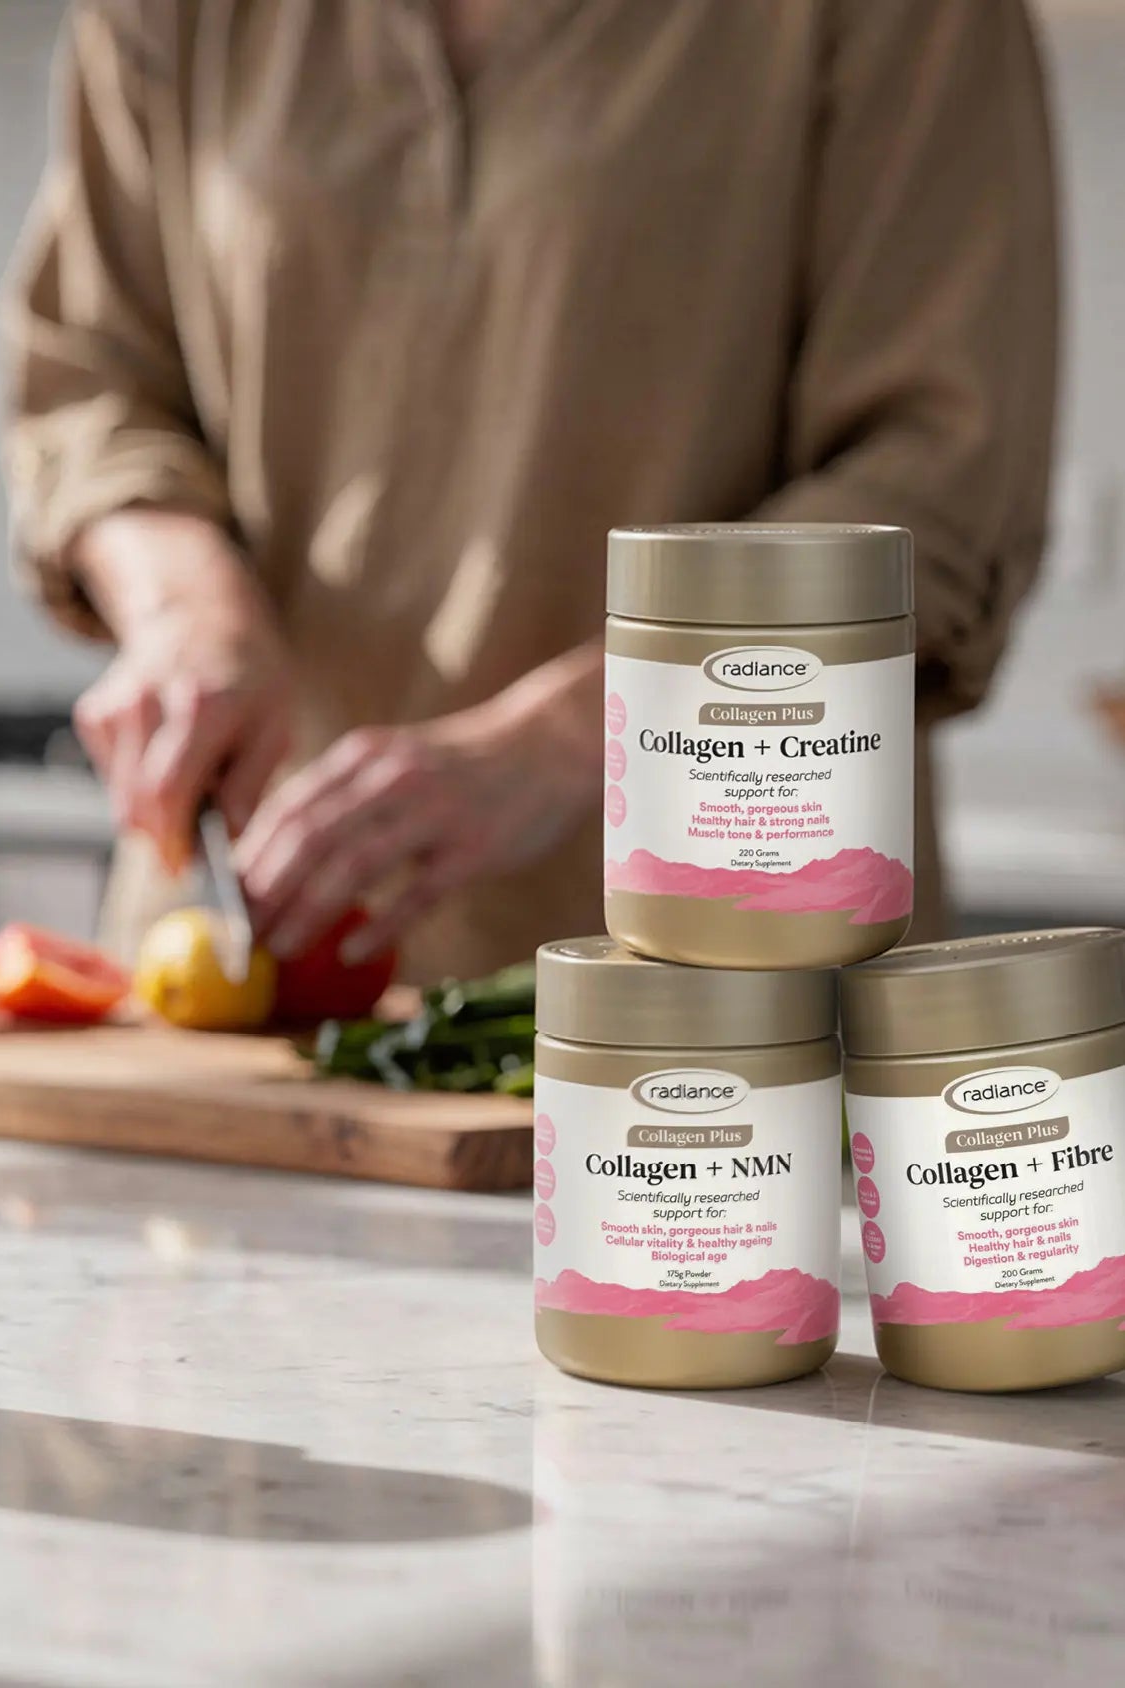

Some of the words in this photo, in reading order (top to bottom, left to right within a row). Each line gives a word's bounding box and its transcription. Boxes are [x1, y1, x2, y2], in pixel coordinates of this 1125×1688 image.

[710, 707, 776, 724] Collagen
[782, 707, 813, 720] Plus
[639, 728, 744, 763] Collagen
[755, 740, 770, 755] +
[780, 730, 881, 758] Creatine
[689, 769, 763, 785] Scientifically
[766, 769, 831, 782] researched
[725, 786, 774, 800] support
[778, 786, 798, 797] for:
[700, 802, 744, 814] Smooth,
[747, 803, 798, 815] gorgeous
[801, 802, 822, 812] skin
[692, 815, 732, 827] Healthy
[735, 815, 756, 826] hair
[759, 816, 766, 826] &
[769, 816, 804, 828] strong
[807, 815, 830, 824] nails
[688, 827, 725, 838] Muscle
[728, 830, 752, 839] tone
[755, 829, 763, 839] &
[766, 828, 834, 841] performance
[739, 849, 754, 857] 220
[756, 849, 779, 857] Grams
[731, 860, 754, 868] Dietary
[755, 859, 791, 868] Supplement
[639, 1130, 705, 1145] Collagen
[710, 1130, 742, 1142] Plus
[956, 1130, 1022, 1147] Collagen
[1027, 1123, 1059, 1138] Plus
[586, 1153, 696, 1186] Collagen
[707, 1161, 723, 1177] +
[731, 1153, 792, 1178] NMN
[906, 1161, 1019, 1190] Collagen
[1027, 1158, 1042, 1172] +
[1051, 1144, 1113, 1172] Fibre
[617, 1190, 691, 1206] Scientifically
[694, 1190, 760, 1203] researched
[943, 1193, 1016, 1208] Scientifically
[1019, 1181, 1084, 1201] researched
[653, 1208, 703, 1221] support
[706, 1207, 727, 1218] for:
[980, 1205, 1029, 1222] support
[1033, 1202, 1053, 1214] for:
[601, 1221, 639, 1233] Smooth
[642, 1224, 666, 1235] skin,
[669, 1225, 721, 1237] gorgeous
[724, 1224, 744, 1234] hair
[746, 1223, 753, 1233] &
[756, 1222, 777, 1231] nails
[958, 1229, 1003, 1241] Smooth,
[1005, 1223, 1056, 1238] gorgeous
[1059, 1217, 1079, 1229] skin
[606, 1235, 644, 1247] Cellular
[647, 1237, 684, 1250] vitality
[687, 1238, 695, 1248] &
[698, 1238, 737, 1249] healthy
[740, 1235, 772, 1248] ageing
[969, 1242, 1010, 1253] Healthy
[1013, 1239, 1034, 1249] hair
[1037, 1236, 1045, 1245] &
[1048, 1232, 1071, 1244] nails
[651, 1251, 705, 1263] Biological
[711, 1253, 727, 1263] age
[964, 1251, 1014, 1267] Digestion
[1017, 1251, 1026, 1260] &
[1028, 1244, 1079, 1260] regularity
[667, 1269, 683, 1280] 175g
[685, 1269, 711, 1278] Powder
[1002, 1269, 1018, 1278] 200
[1019, 1267, 1043, 1277] Grams
[659, 1280, 682, 1289] Dietary
[683, 1280, 719, 1288] Supplement
[995, 1280, 1018, 1289] Dietary
[1019, 1276, 1055, 1287] Supplement
